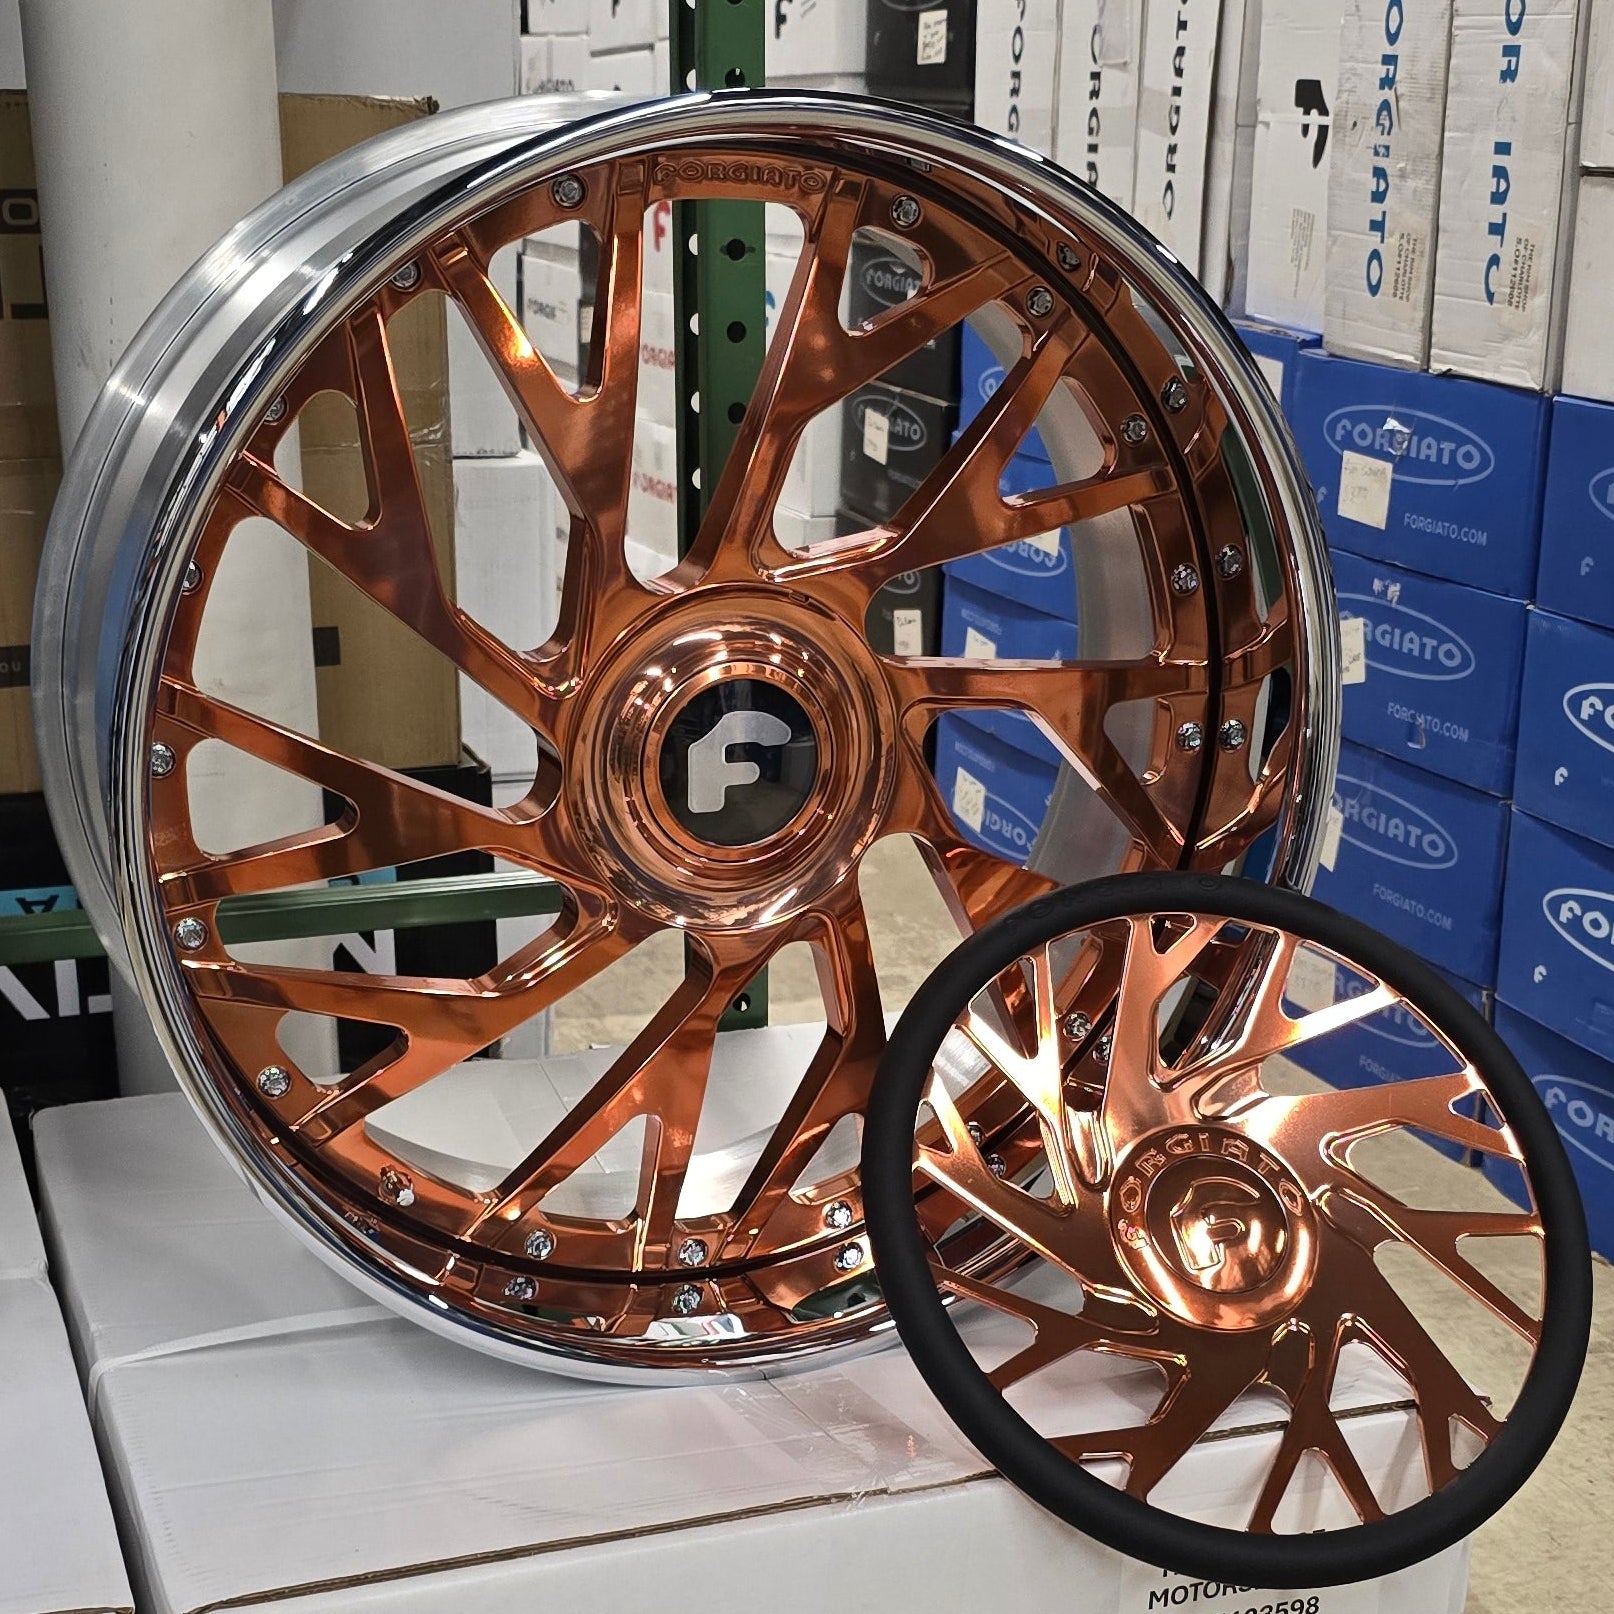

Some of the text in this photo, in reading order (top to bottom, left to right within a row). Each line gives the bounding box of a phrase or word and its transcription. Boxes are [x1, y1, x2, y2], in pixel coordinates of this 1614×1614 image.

[653, 157, 828, 194] FORGIATO
[1403, 512, 1488, 546] FORGIATO.COM
[688, 710, 792, 814] F
[1373, 883, 1452, 931] FORGIATO.COM
